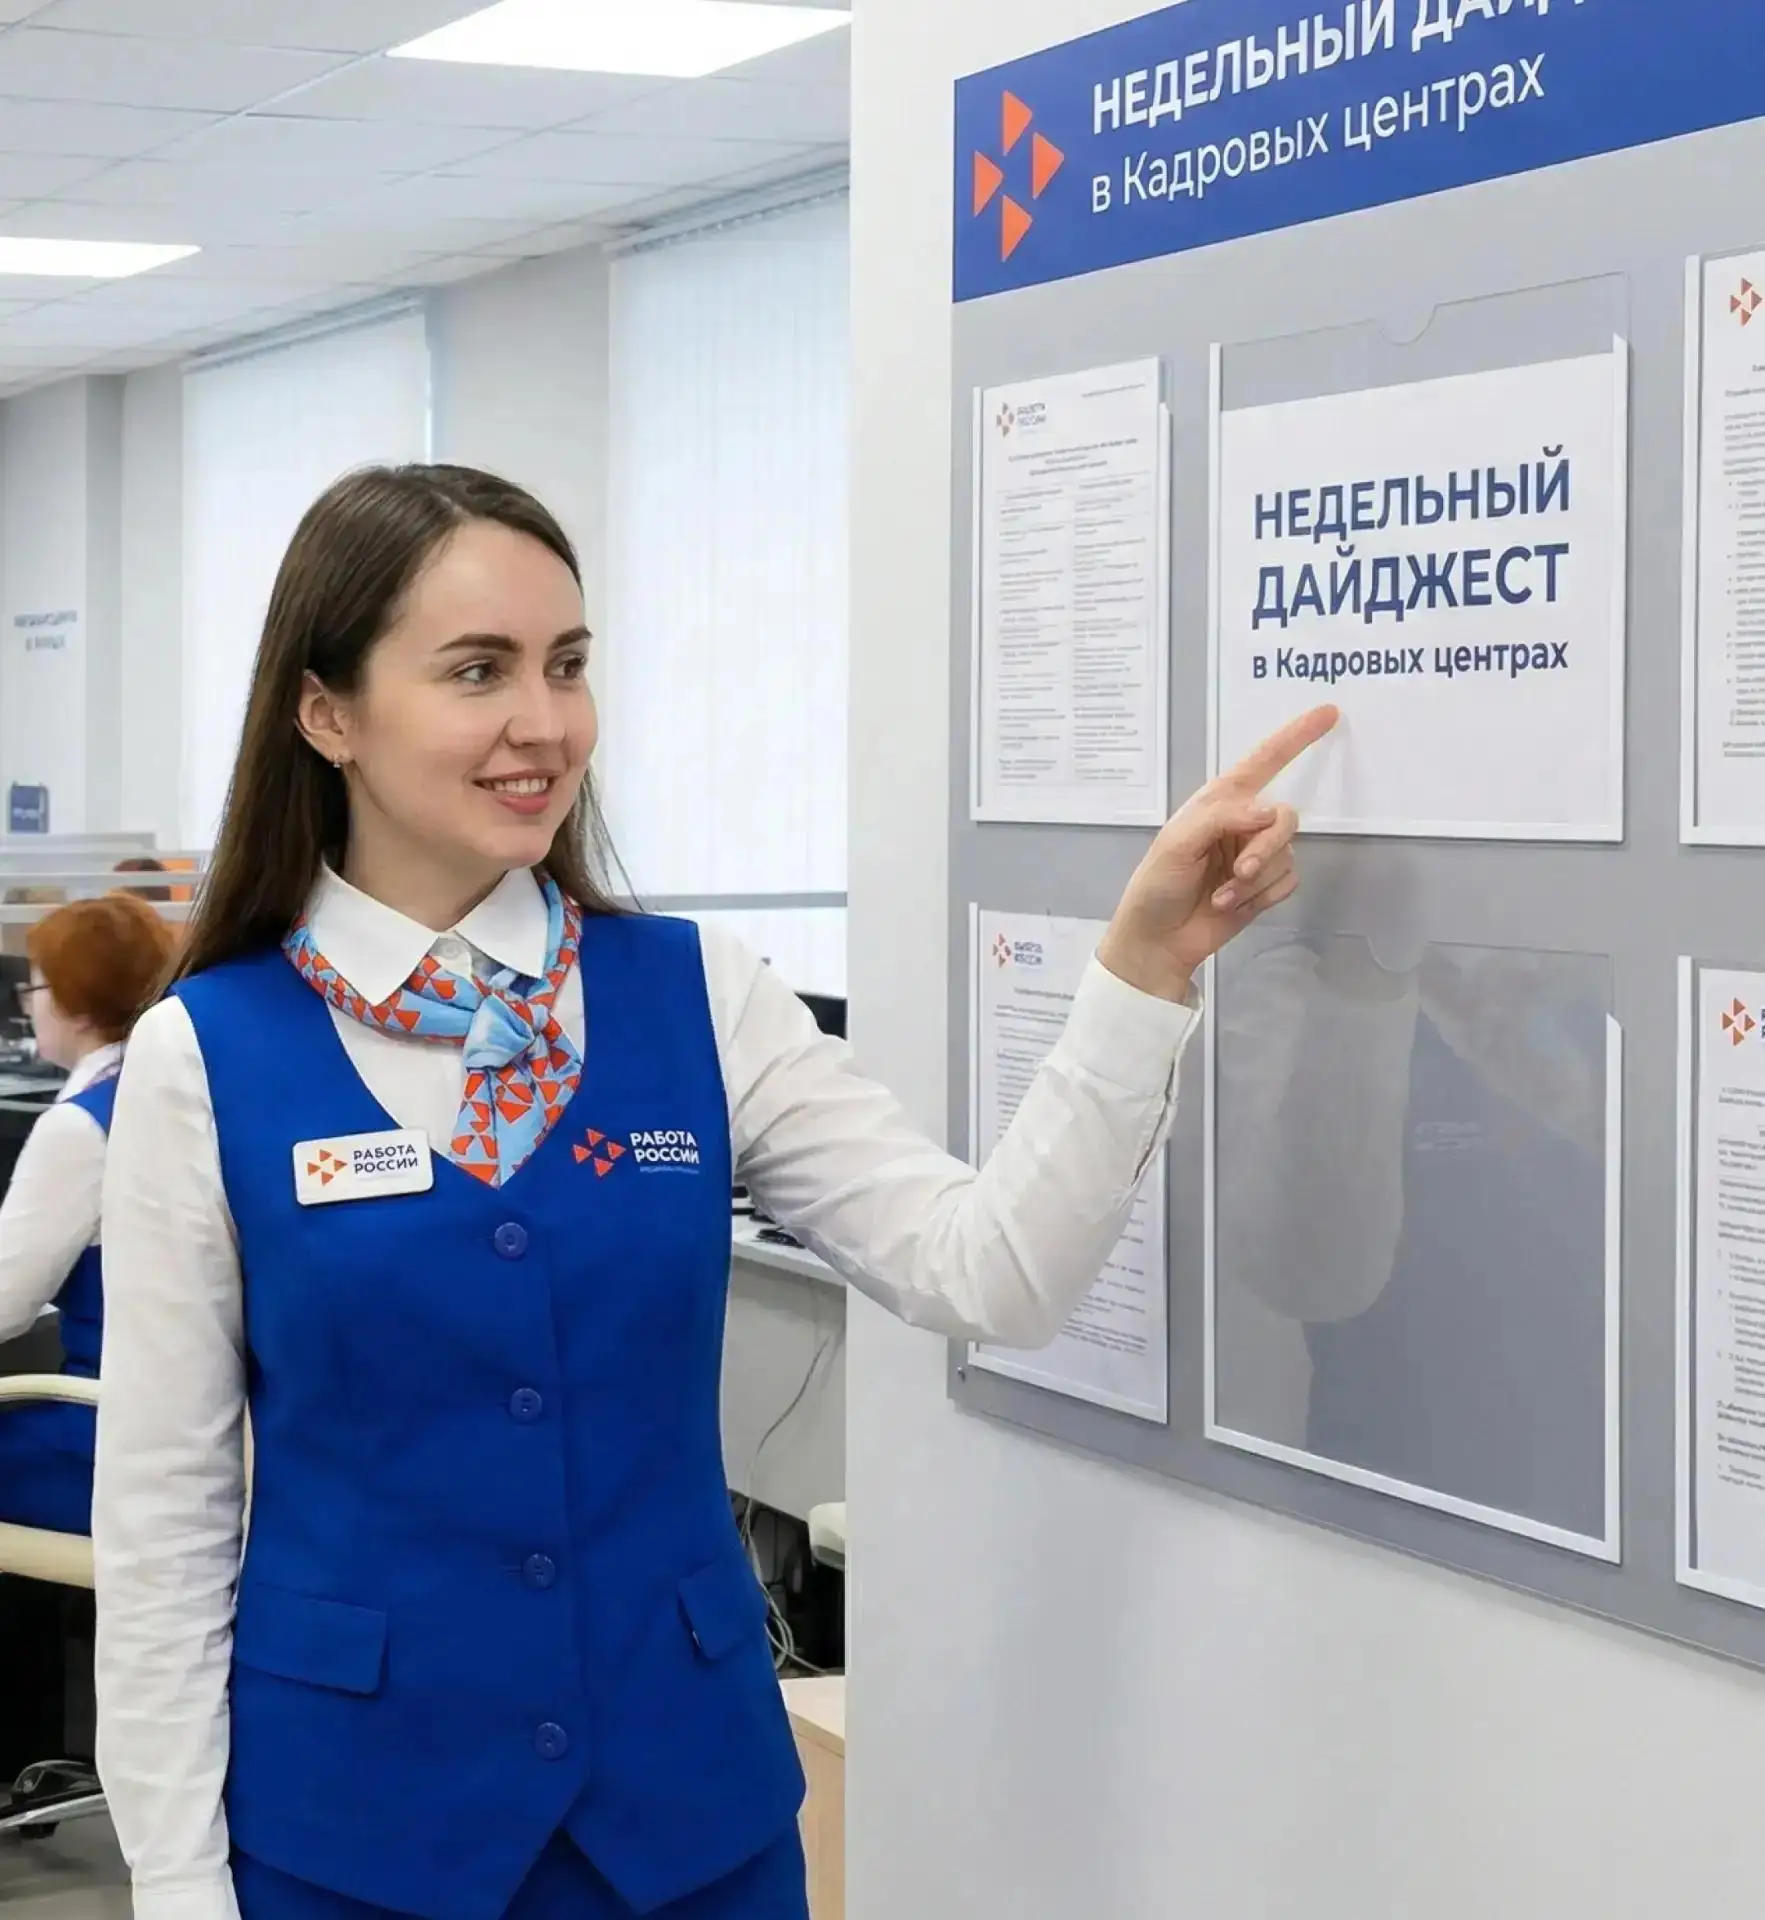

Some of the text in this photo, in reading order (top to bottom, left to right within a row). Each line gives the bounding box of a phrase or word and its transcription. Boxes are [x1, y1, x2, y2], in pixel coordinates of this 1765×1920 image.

[1092, 53, 1546, 214] в Кадровых центрах
[1254, 444, 1570, 544] НЕДЕЛЬНЫЙ
[1251, 542, 1570, 630] ДАЙДЖЕСТ
[1252, 641, 1569, 685] в Кадровых центрах
[353, 1143, 417, 1161] РАБОТА
[629, 1129, 698, 1148] РАБОТА
[354, 1157, 419, 1175] РОССИИ
[633, 1146, 700, 1165] РОССИИ
